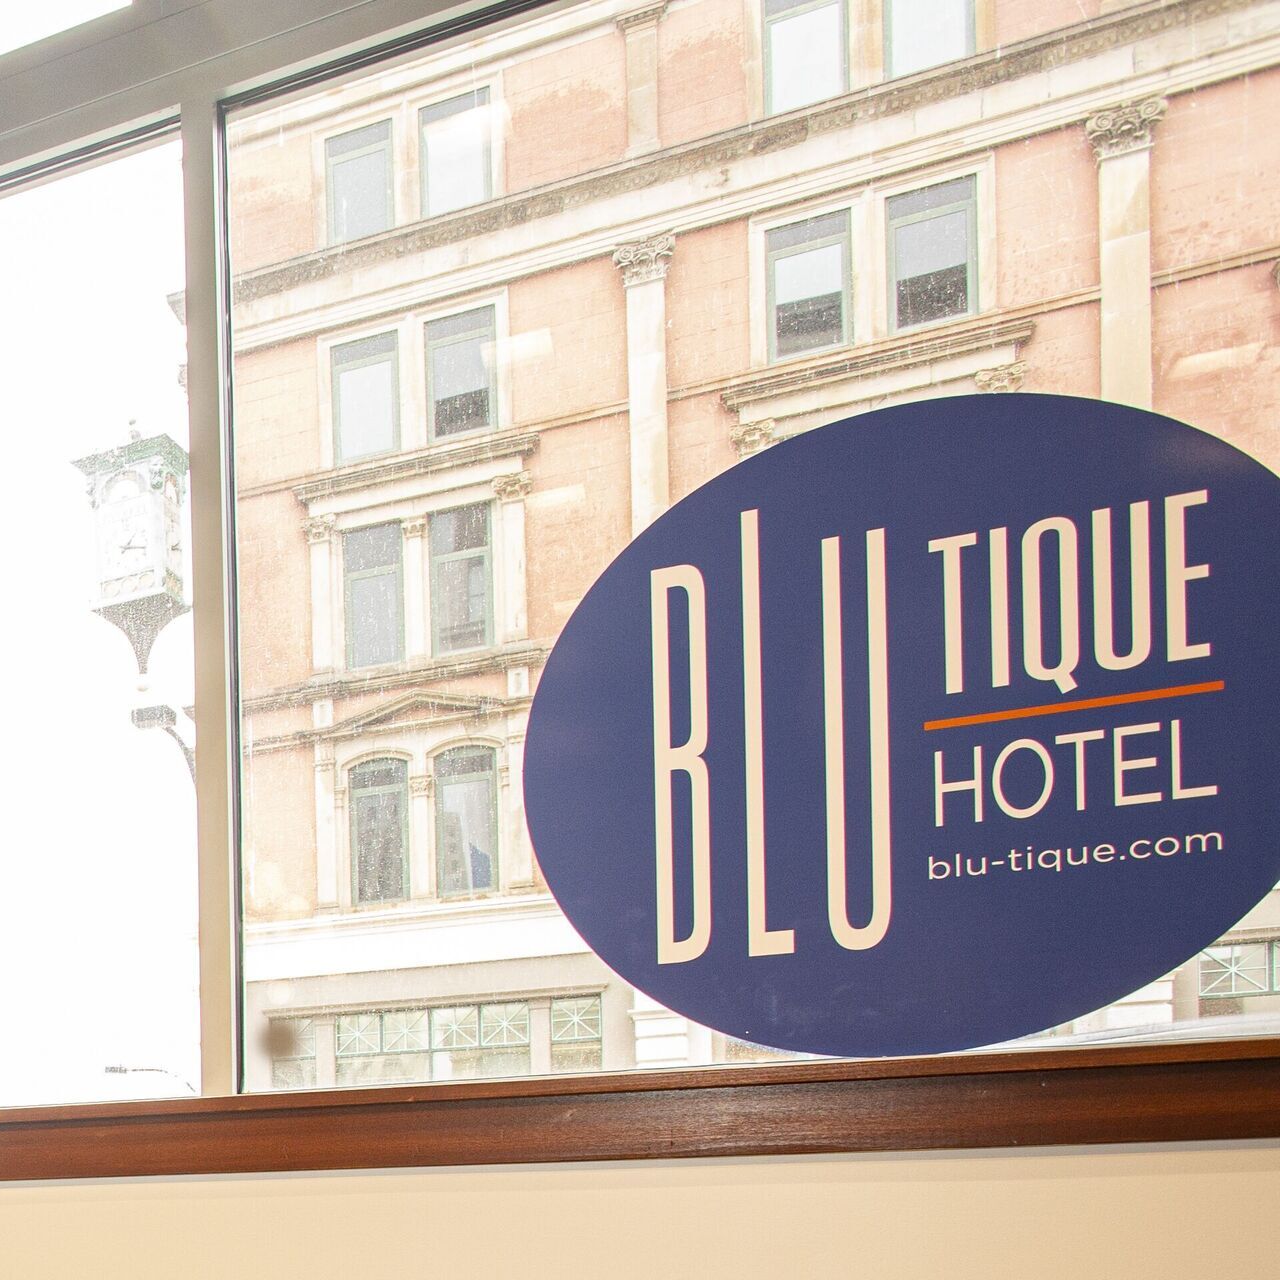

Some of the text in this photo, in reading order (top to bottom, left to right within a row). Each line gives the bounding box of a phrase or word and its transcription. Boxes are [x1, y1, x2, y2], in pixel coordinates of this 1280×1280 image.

[650, 489, 1212, 966] BLU TIQUE
[934, 719, 1219, 828] HOTEL
[928, 831, 1224, 881] blu-tique.com
